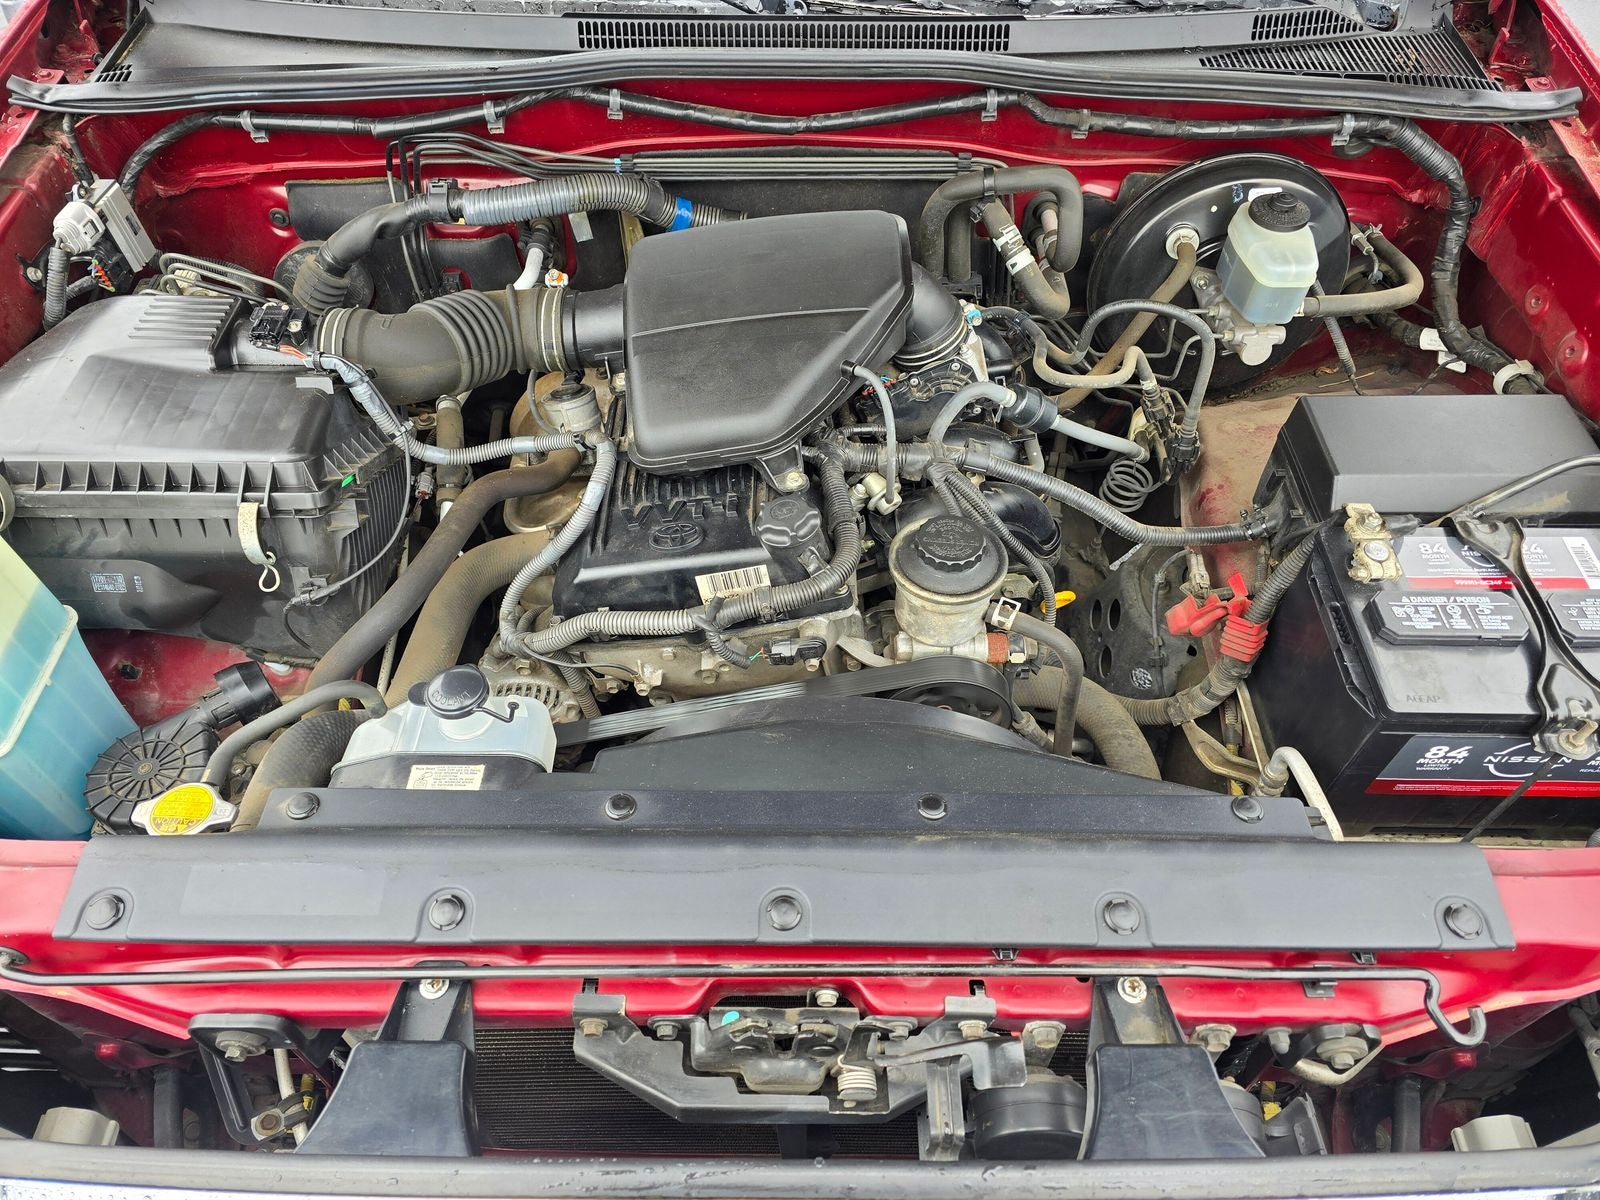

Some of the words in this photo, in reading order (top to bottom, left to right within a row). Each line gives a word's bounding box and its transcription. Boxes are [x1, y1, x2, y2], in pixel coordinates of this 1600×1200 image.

[1418, 542, 1447, 554] 84
[431, 689, 471, 706] COOLANT
[1424, 745, 1473, 759] 84
